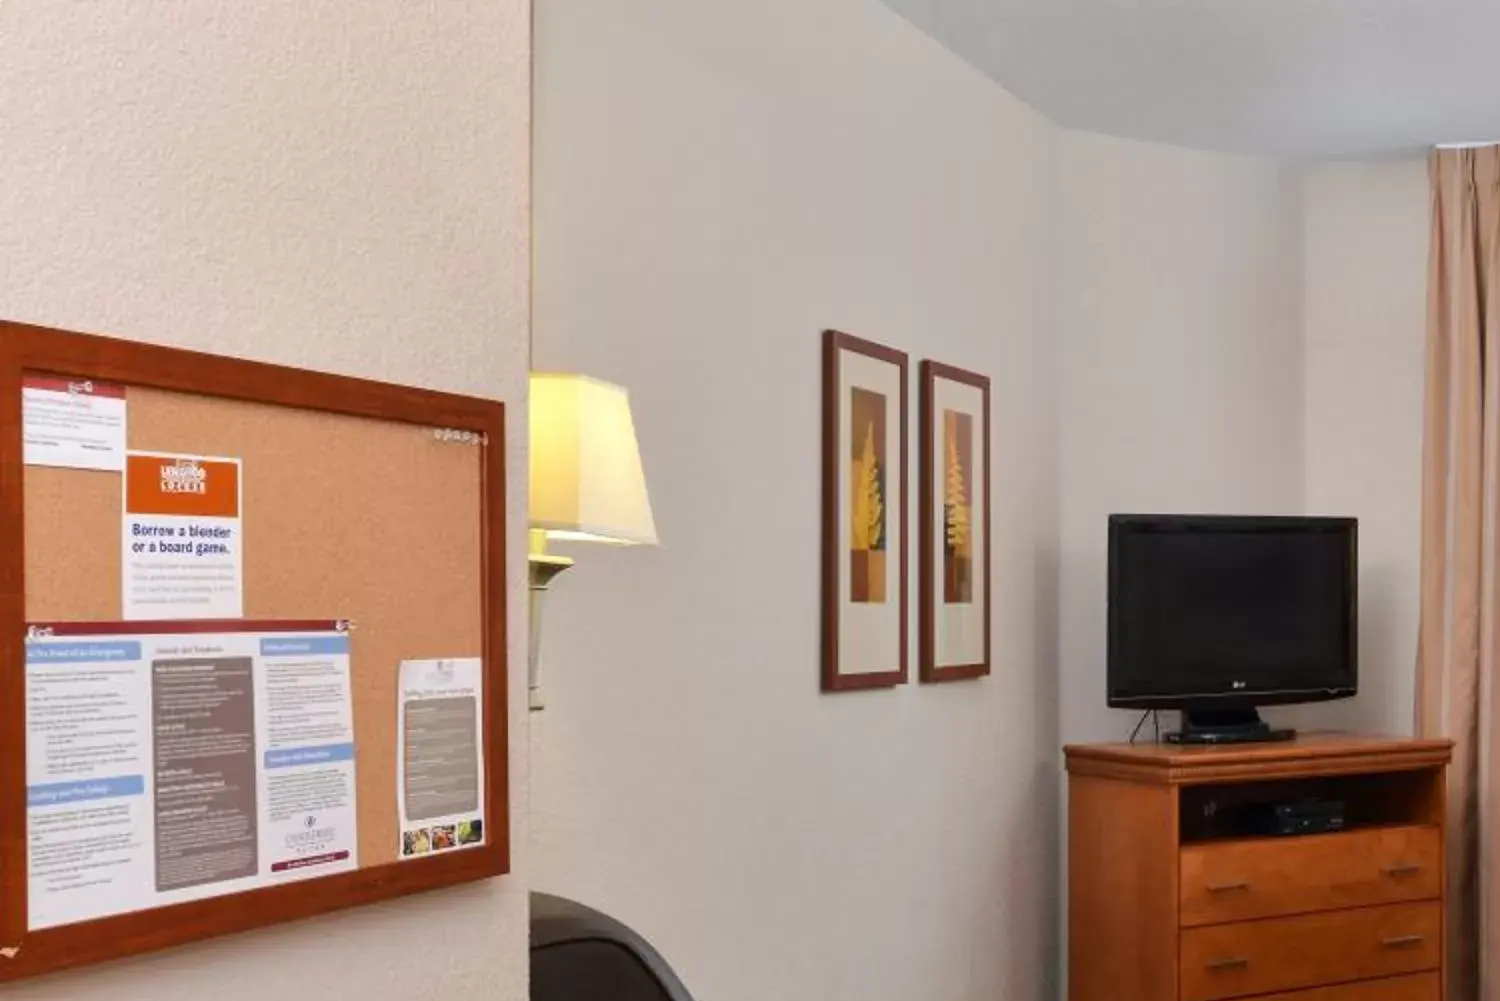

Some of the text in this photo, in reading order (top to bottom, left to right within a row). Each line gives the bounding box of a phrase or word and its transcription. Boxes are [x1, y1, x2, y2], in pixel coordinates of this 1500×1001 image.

[132, 523, 231, 538] Borrow a blender
[132, 542, 145, 553] or
[149, 542, 156, 552] a
[159, 540, 193, 553] board
